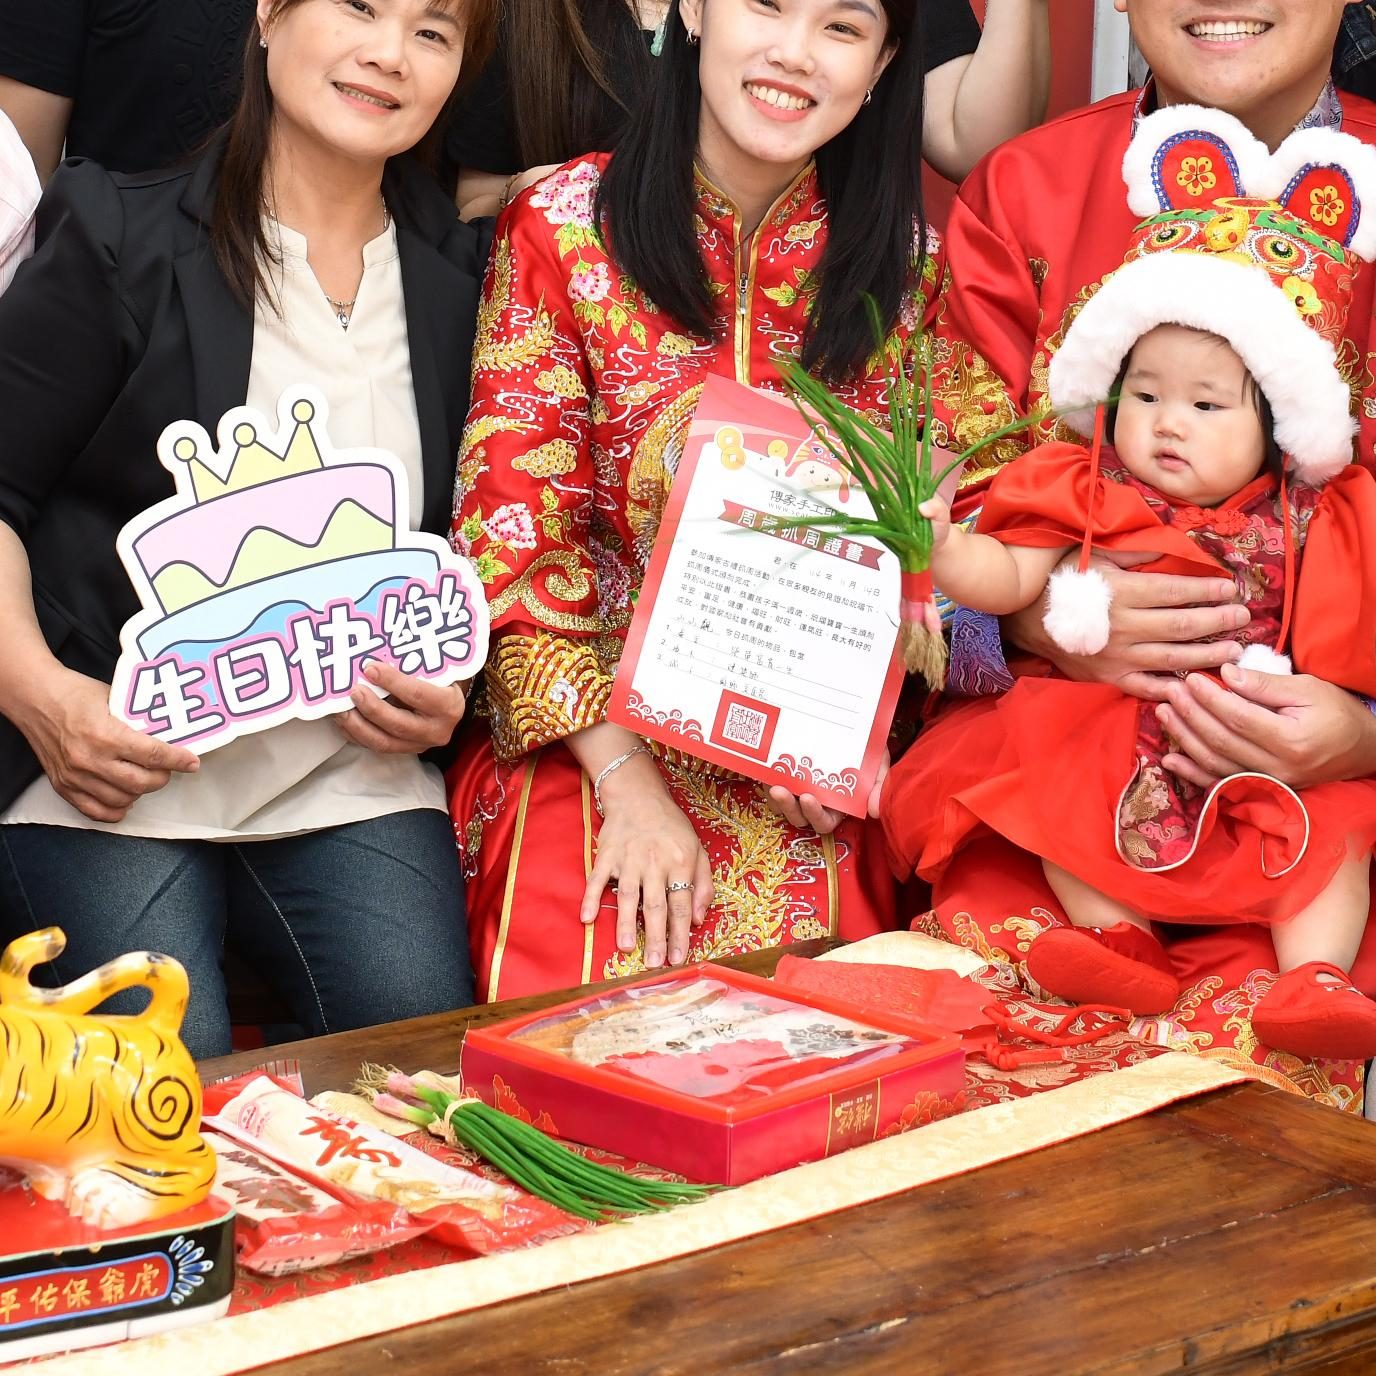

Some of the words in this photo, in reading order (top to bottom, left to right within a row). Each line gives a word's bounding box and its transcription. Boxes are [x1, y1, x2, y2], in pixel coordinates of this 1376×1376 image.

[769, 489, 849, 522] 傳家手工印
[129, 573, 472, 744] 生日快樂
